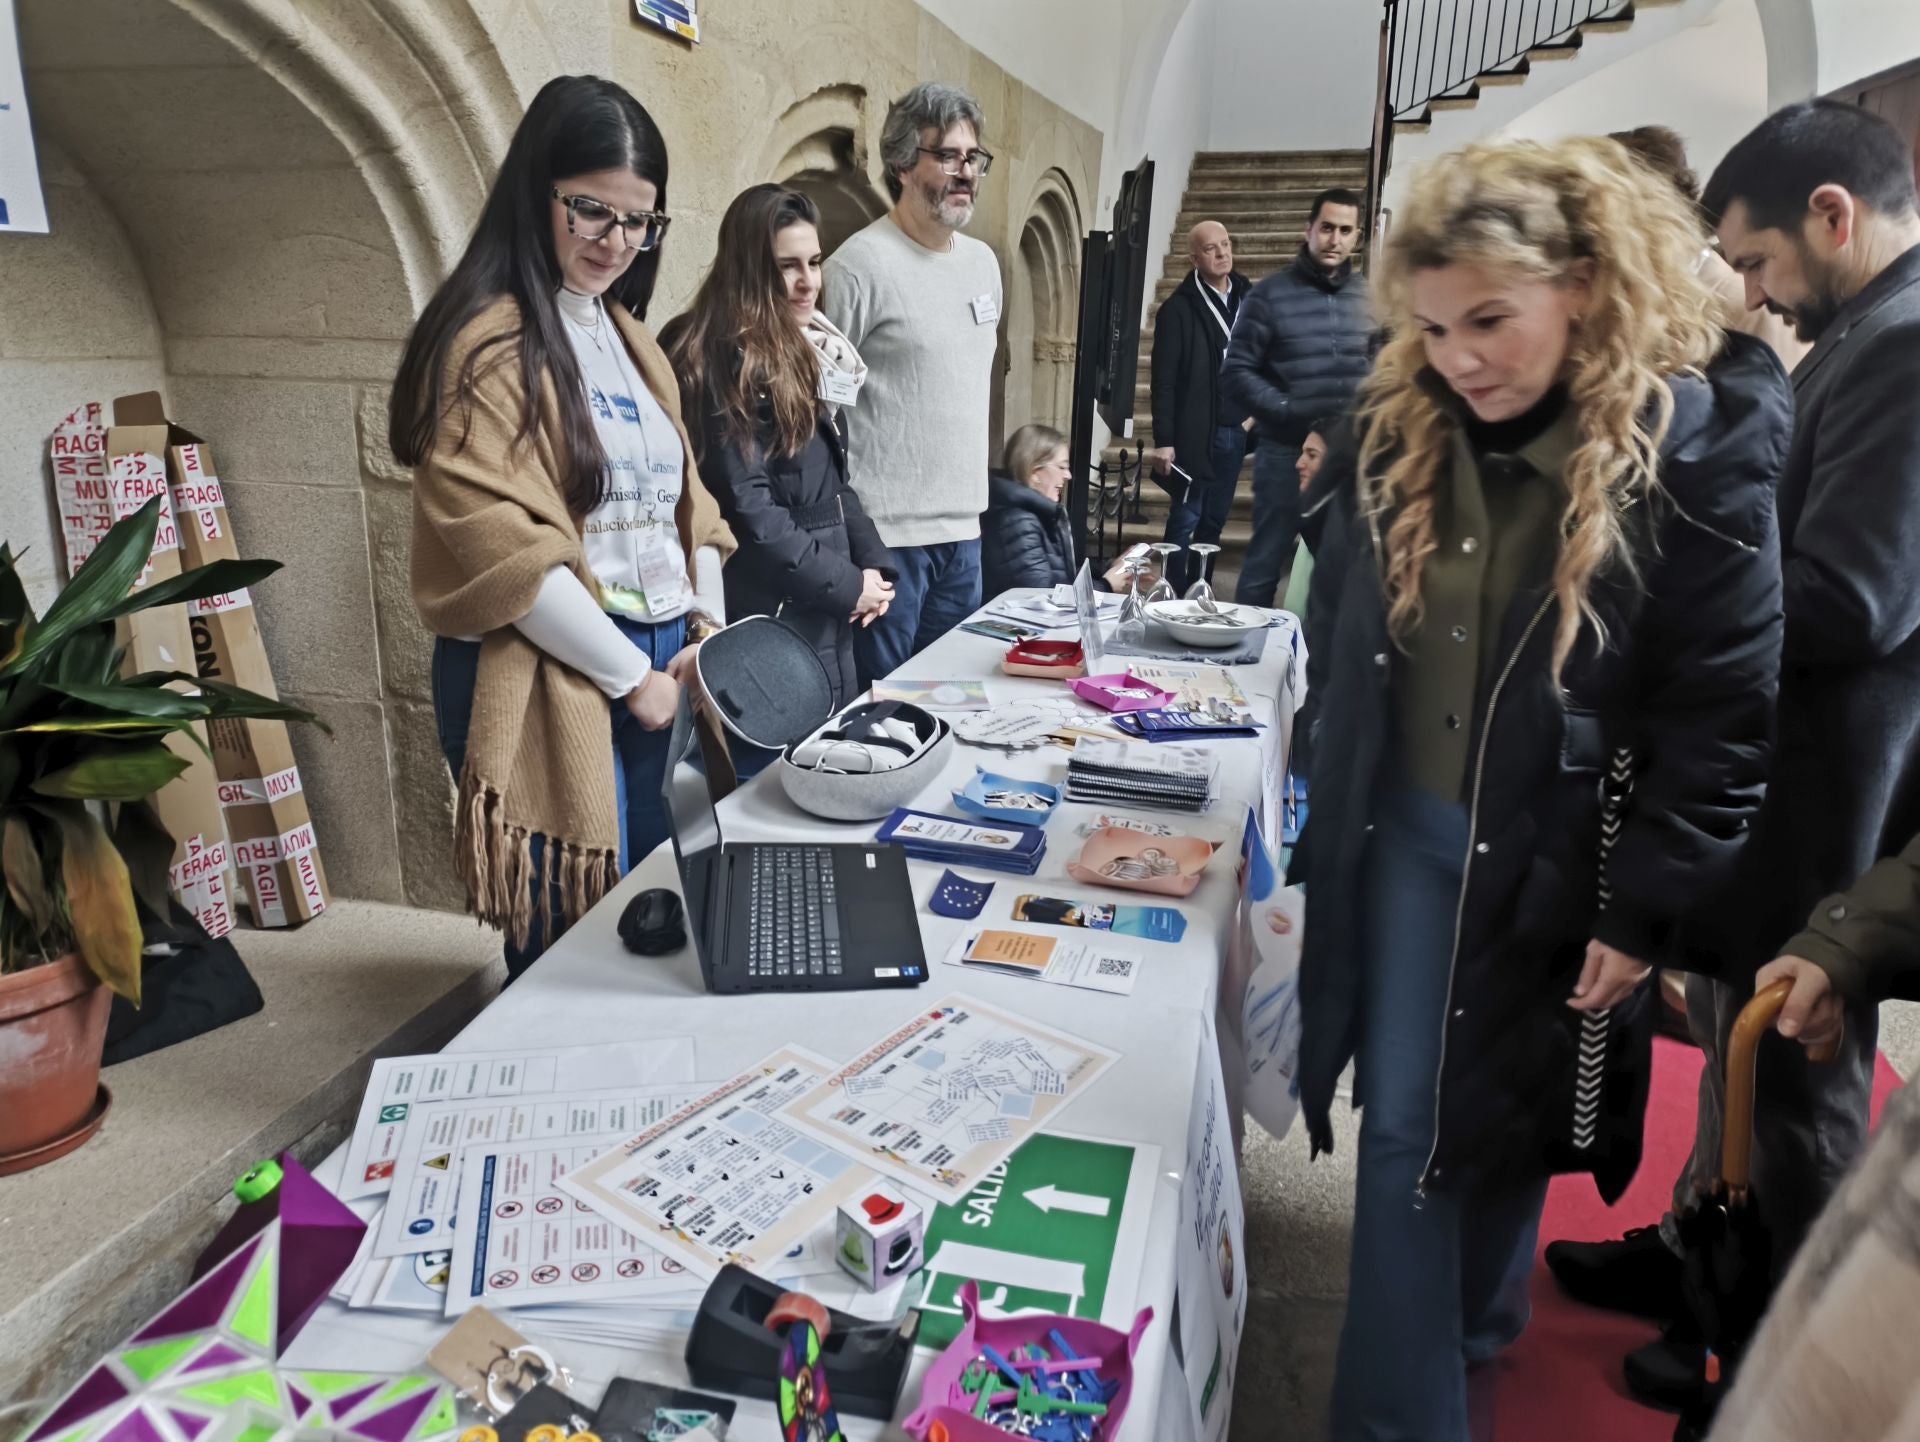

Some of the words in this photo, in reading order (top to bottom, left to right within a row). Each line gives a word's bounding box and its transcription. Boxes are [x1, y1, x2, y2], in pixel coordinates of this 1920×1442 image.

[75, 479, 119, 499] MUY
[266, 772, 296, 798] MUY
[298, 855, 319, 897] MUY
[962, 1157, 1011, 1228] SALID
